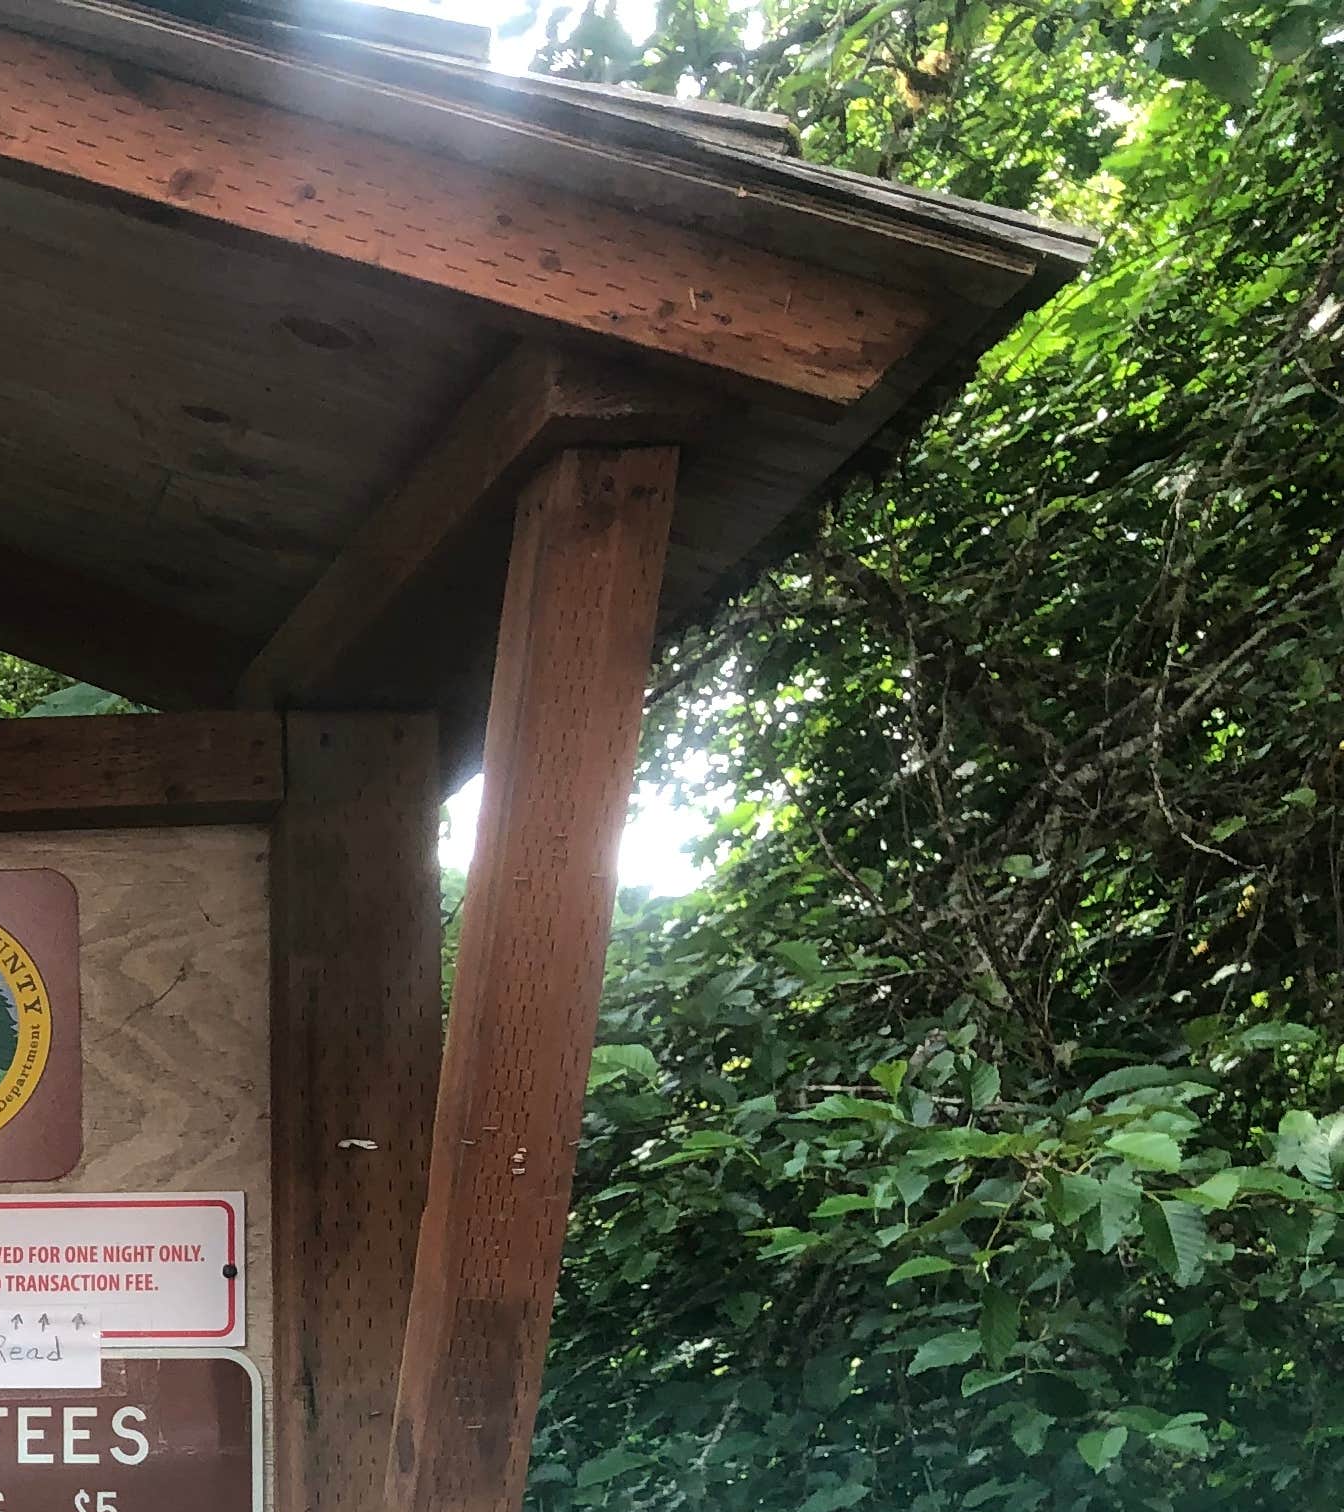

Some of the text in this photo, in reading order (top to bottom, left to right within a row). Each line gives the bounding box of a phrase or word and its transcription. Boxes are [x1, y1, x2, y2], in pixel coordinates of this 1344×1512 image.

[28, 1245, 60, 1263] FOR
[65, 1245, 98, 1263] ONE
[103, 1244, 153, 1263] NIGHT
[159, 1244, 205, 1262] ONLY.
[6, 1274, 120, 1292] TRANSACTION
[125, 1273, 158, 1291] FEE.
